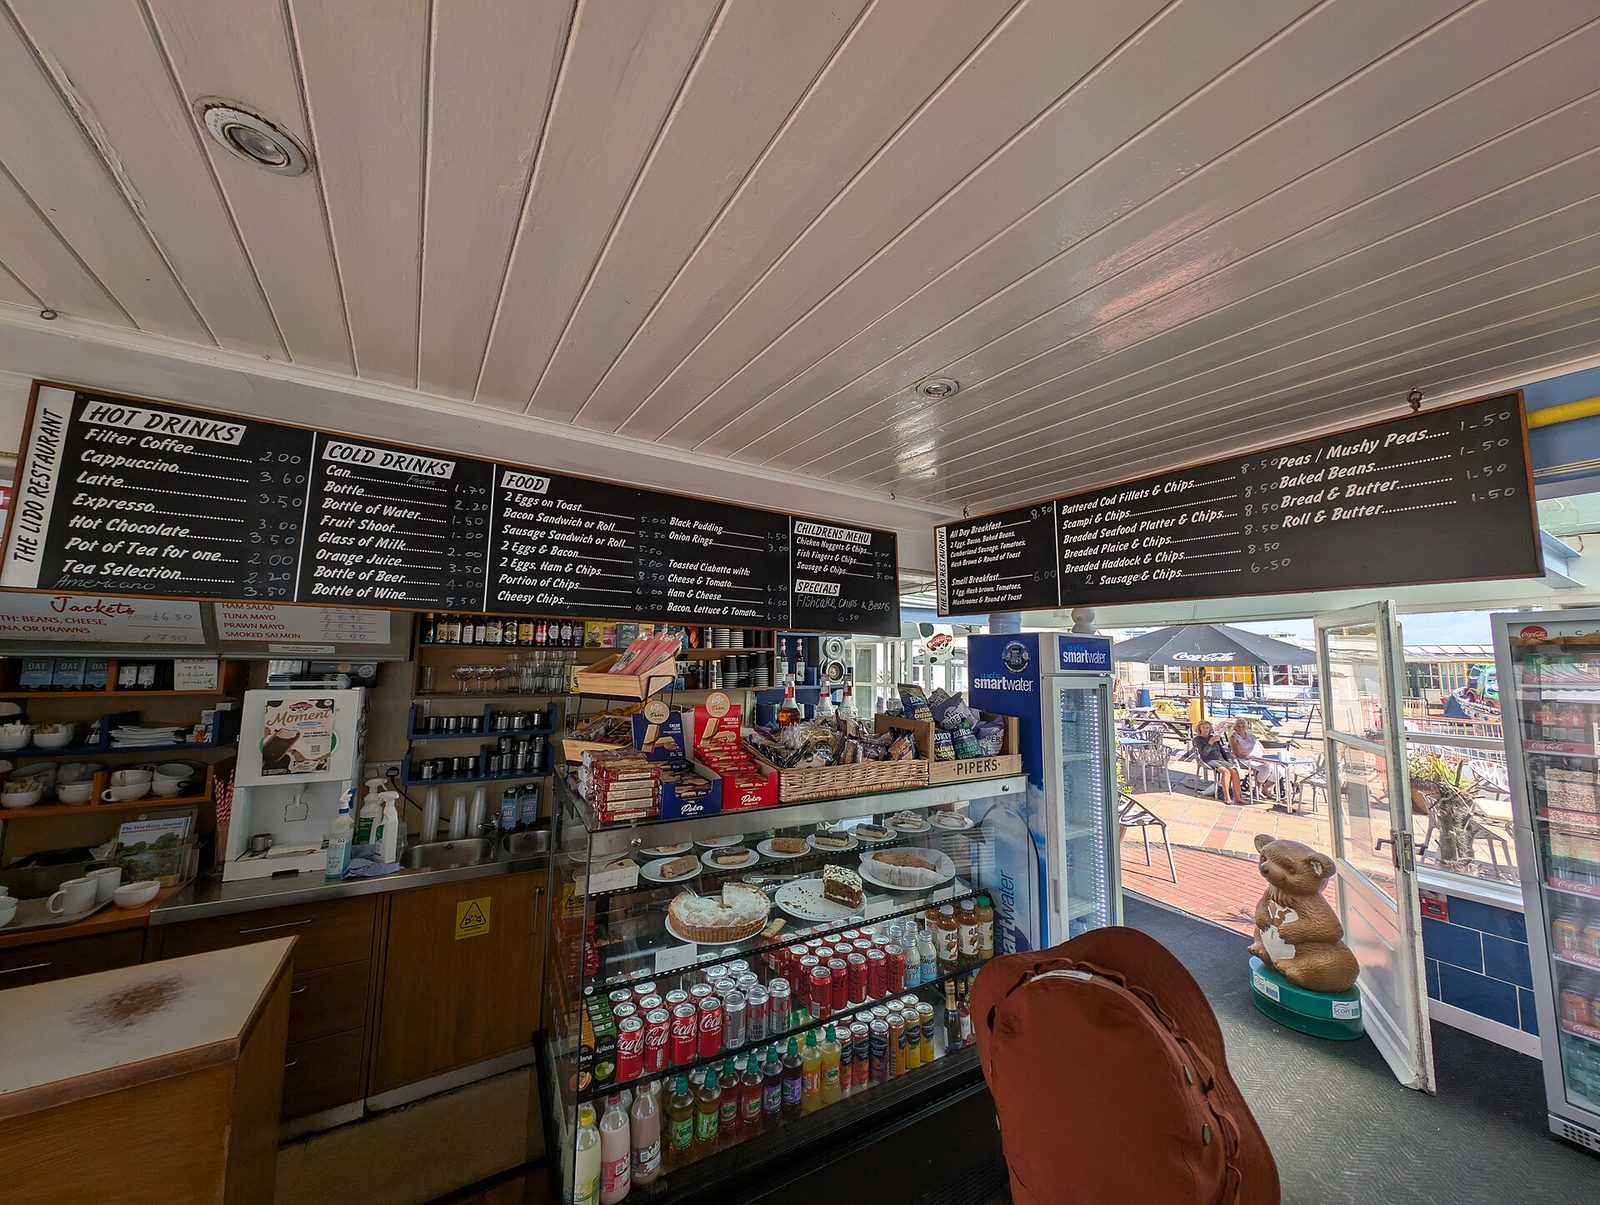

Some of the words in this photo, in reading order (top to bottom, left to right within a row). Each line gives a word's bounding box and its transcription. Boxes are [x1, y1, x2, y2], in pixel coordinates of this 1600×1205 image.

[89, 404, 141, 426] HOT
[144, 412, 242, 442] DRINKS
[27, 408, 63, 498] RESTAURANT
[84, 428, 135, 446] Filter
[139, 436, 194, 455] Coffee
[259, 451, 301, 465] 2.00
[1278, 453, 1311, 470] Peas
[1326, 438, 1380, 461] Mushy
[1384, 428, 1428, 448] Peas
[80, 450, 180, 474] Cappuccino
[328, 444, 376, 464] COLD
[379, 453, 450, 476] DRINKS
[326, 464, 351, 478] Can
[1278, 472, 1324, 490] Baked
[1328, 461, 1376, 481] Beans
[76, 470, 124, 488] Latte
[259, 492, 303, 508] 3.50
[324, 481, 365, 496] Bottle
[506, 475, 545, 492] FOOD
[72, 493, 155, 514] Expresso
[514, 494, 540, 508] Eggs
[556, 500, 582, 512] Toast
[1062, 498, 1098, 514] Battered
[1100, 494, 1117, 507] Cod
[1118, 490, 1150, 503] Fillets
[1164, 480, 1194, 494] Chips
[1280, 493, 1324, 510] Bread
[1346, 479, 1400, 498] Butter
[21, 499, 45, 534] LIDO
[322, 497, 363, 513] Bottle
[382, 506, 421, 520] Water
[1282, 512, 1311, 528] Roll
[1332, 502, 1384, 521] Butter
[69, 515, 103, 530] Hot
[105, 518, 190, 538] Chocolate
[320, 515, 356, 528] Fruit
[358, 519, 395, 533] Shoot
[503, 508, 534, 521] Bacon
[536, 512, 582, 528] Sandwich
[597, 521, 615, 532] Roll
[669, 516, 692, 528] Black
[692, 520, 723, 535] Pudding
[1062, 515, 1093, 530] Scampi
[1104, 509, 1130, 522] Chips
[1063, 530, 1098, 544] Breaded
[1100, 522, 1138, 538] Seafood
[1139, 518, 1176, 532] Platter
[1191, 510, 1224, 523] Chips
[502, 524, 546, 540] Sausage
[548, 530, 593, 545] Sandwich
[607, 538, 626, 548] Roll
[668, 531, 690, 542] Onion
[692, 534, 714, 546] Rings
[796, 522, 844, 540] CHILDRENS
[844, 531, 870, 544] MENU
[950, 530, 958, 538] All
[959, 528, 970, 537] Day
[970, 521, 1002, 535] Breakfast
[14, 534, 38, 563] THE
[318, 532, 356, 546] Glass
[375, 538, 406, 551] Milk
[511, 542, 536, 556] Eggs
[550, 546, 579, 558] Bacon
[1064, 544, 1099, 559] Breaded
[1100, 542, 1129, 554] Plaice
[1142, 536, 1172, 548] Chips
[65, 538, 99, 552] Pot
[102, 540, 124, 555] of
[127, 542, 156, 557] Tea
[161, 544, 188, 560] for
[192, 550, 222, 561] one
[247, 554, 293, 566] 2.00
[316, 548, 364, 566] Orange
[366, 552, 402, 566] Juice
[796, 548, 810, 558] Fish
[811, 550, 834, 562] Fingers
[840, 554, 857, 565] Chips
[62, 560, 96, 574] Tea
[100, 562, 181, 580] Selection
[540, 561, 562, 572] Ham
[576, 564, 602, 577] Chips
[668, 560, 699, 571] Toasted
[700, 562, 732, 574] Ciabatta
[732, 566, 750, 576] with:
[796, 562, 822, 574] Sausage
[830, 565, 846, 576] Chips
[1064, 560, 1100, 574] Breaded
[1102, 555, 1141, 570] Haddock
[1155, 550, 1184, 563] Chips
[314, 566, 356, 580] Bottle
[375, 570, 406, 584] Beer
[498, 574, 538, 586] Portion
[552, 578, 580, 591] Chips
[668, 574, 695, 585] Cheese
[705, 577, 732, 588] Tomato
[952, 576, 968, 586] Small
[968, 573, 999, 585] Breakfast
[1152, 568, 1182, 580] Chips
[312, 582, 354, 597] Bottle
[374, 588, 407, 600] Wine
[668, 588, 685, 598] Ham
[696, 591, 722, 600] Cheese
[796, 582, 839, 595] SPECIALS
[50, 596, 135, 618] Jackets
[498, 590, 534, 604] Cheesy
[536, 593, 564, 606] Chips
[694, 604, 721, 614] Lettuce
[730, 607, 757, 617] Tomato
[42, 626, 90, 634] PRAWNS
[1521, 630, 1546, 638] Coca-Cola
[1063, 650, 1106, 664] smartwater
[1172, 652, 1236, 662] Coca-Cola
[974, 676, 1033, 692] smartwater
[266, 709, 332, 726] Moment
[1531, 742, 1564, 751] Coca-Cola
[741, 794, 762, 806] Poker
[681, 804, 704, 815] Poker
[1558, 880, 1592, 892] Coca-Cola
